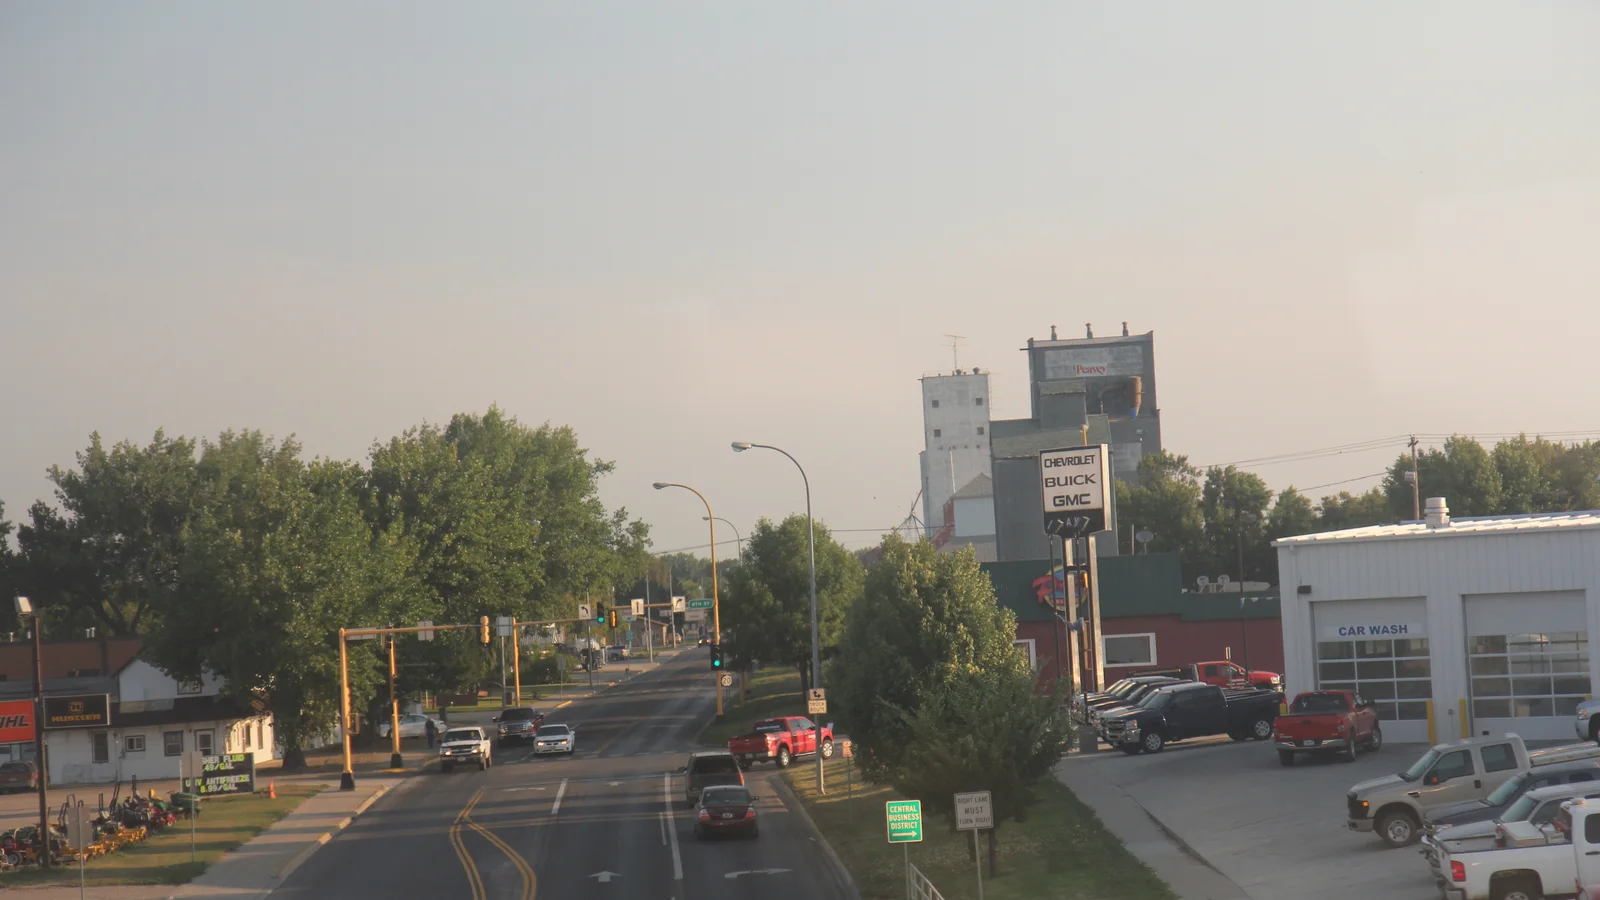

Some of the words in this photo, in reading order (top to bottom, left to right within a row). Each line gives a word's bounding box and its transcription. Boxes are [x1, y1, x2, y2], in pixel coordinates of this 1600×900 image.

[1076, 364, 1106, 374] Peavey
[1044, 454, 1095, 468] CHEVROLET
[1045, 473, 1096, 488] BUICK
[1053, 493, 1091, 507] GMC
[1338, 626, 1365, 636] CAR
[1369, 624, 1408, 635] WASH
[0, 714, 29, 728] IHL
[51, 713, 101, 722] HUSTLER
[223, 750, 245, 762] FLUID
[185, 779, 203, 787] UIV
[206, 774, 250, 786] ANTIFREEZE
[200, 783, 238, 793] 8.99/GAL
[958, 797, 973, 805] RIGHT
[975, 795, 988, 803] LANE
[889, 805, 917, 813] CENTRAL
[964, 806, 984, 814] MUST
[888, 814, 919, 822] BUSINESS
[890, 822, 918, 830] DISTRICT
